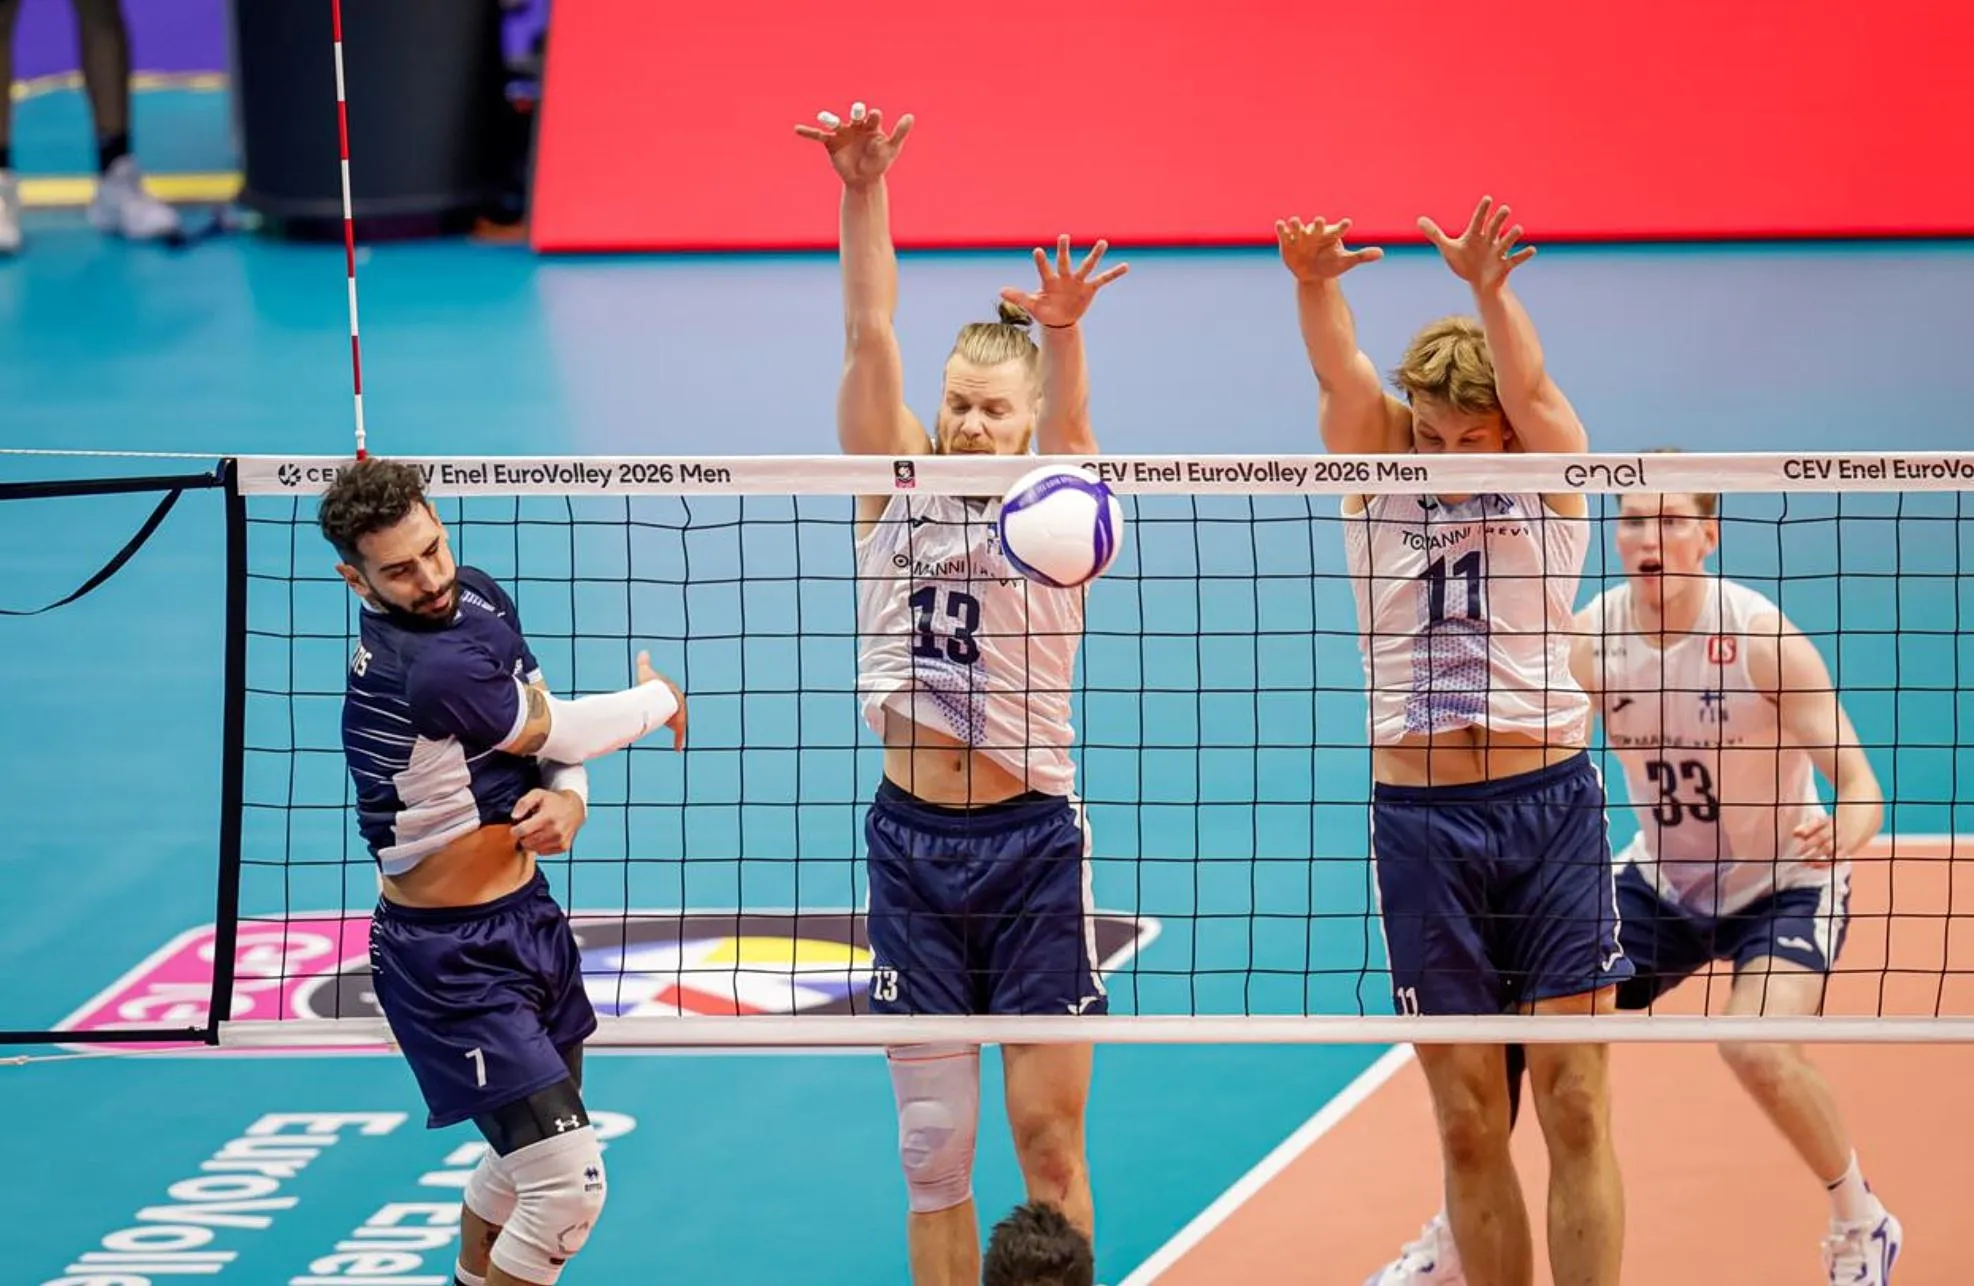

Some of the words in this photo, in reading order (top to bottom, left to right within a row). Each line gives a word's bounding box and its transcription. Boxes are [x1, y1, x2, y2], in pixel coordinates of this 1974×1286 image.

[441, 463, 487, 484] Enel
[494, 463, 612, 488] EuroVolley
[619, 463, 674, 484] 2026
[680, 463, 731, 484] Men
[1134, 461, 1182, 482] Enel
[1188, 461, 1308, 487] EuroVolley
[1314, 461, 1371, 482] 2026
[1377, 461, 1428, 482] Men
[1564, 457, 1646, 487] enel
[1783, 459, 1832, 480] CEV
[1838, 457, 1887, 480] Enel
[1418, 550, 1482, 622] 11
[908, 586, 981, 665] 13
[1645, 758, 1720, 828] 33
[872, 970, 899, 1002] 13
[1397, 986, 1419, 1016] 11
[465, 1046, 487, 1088] 7
